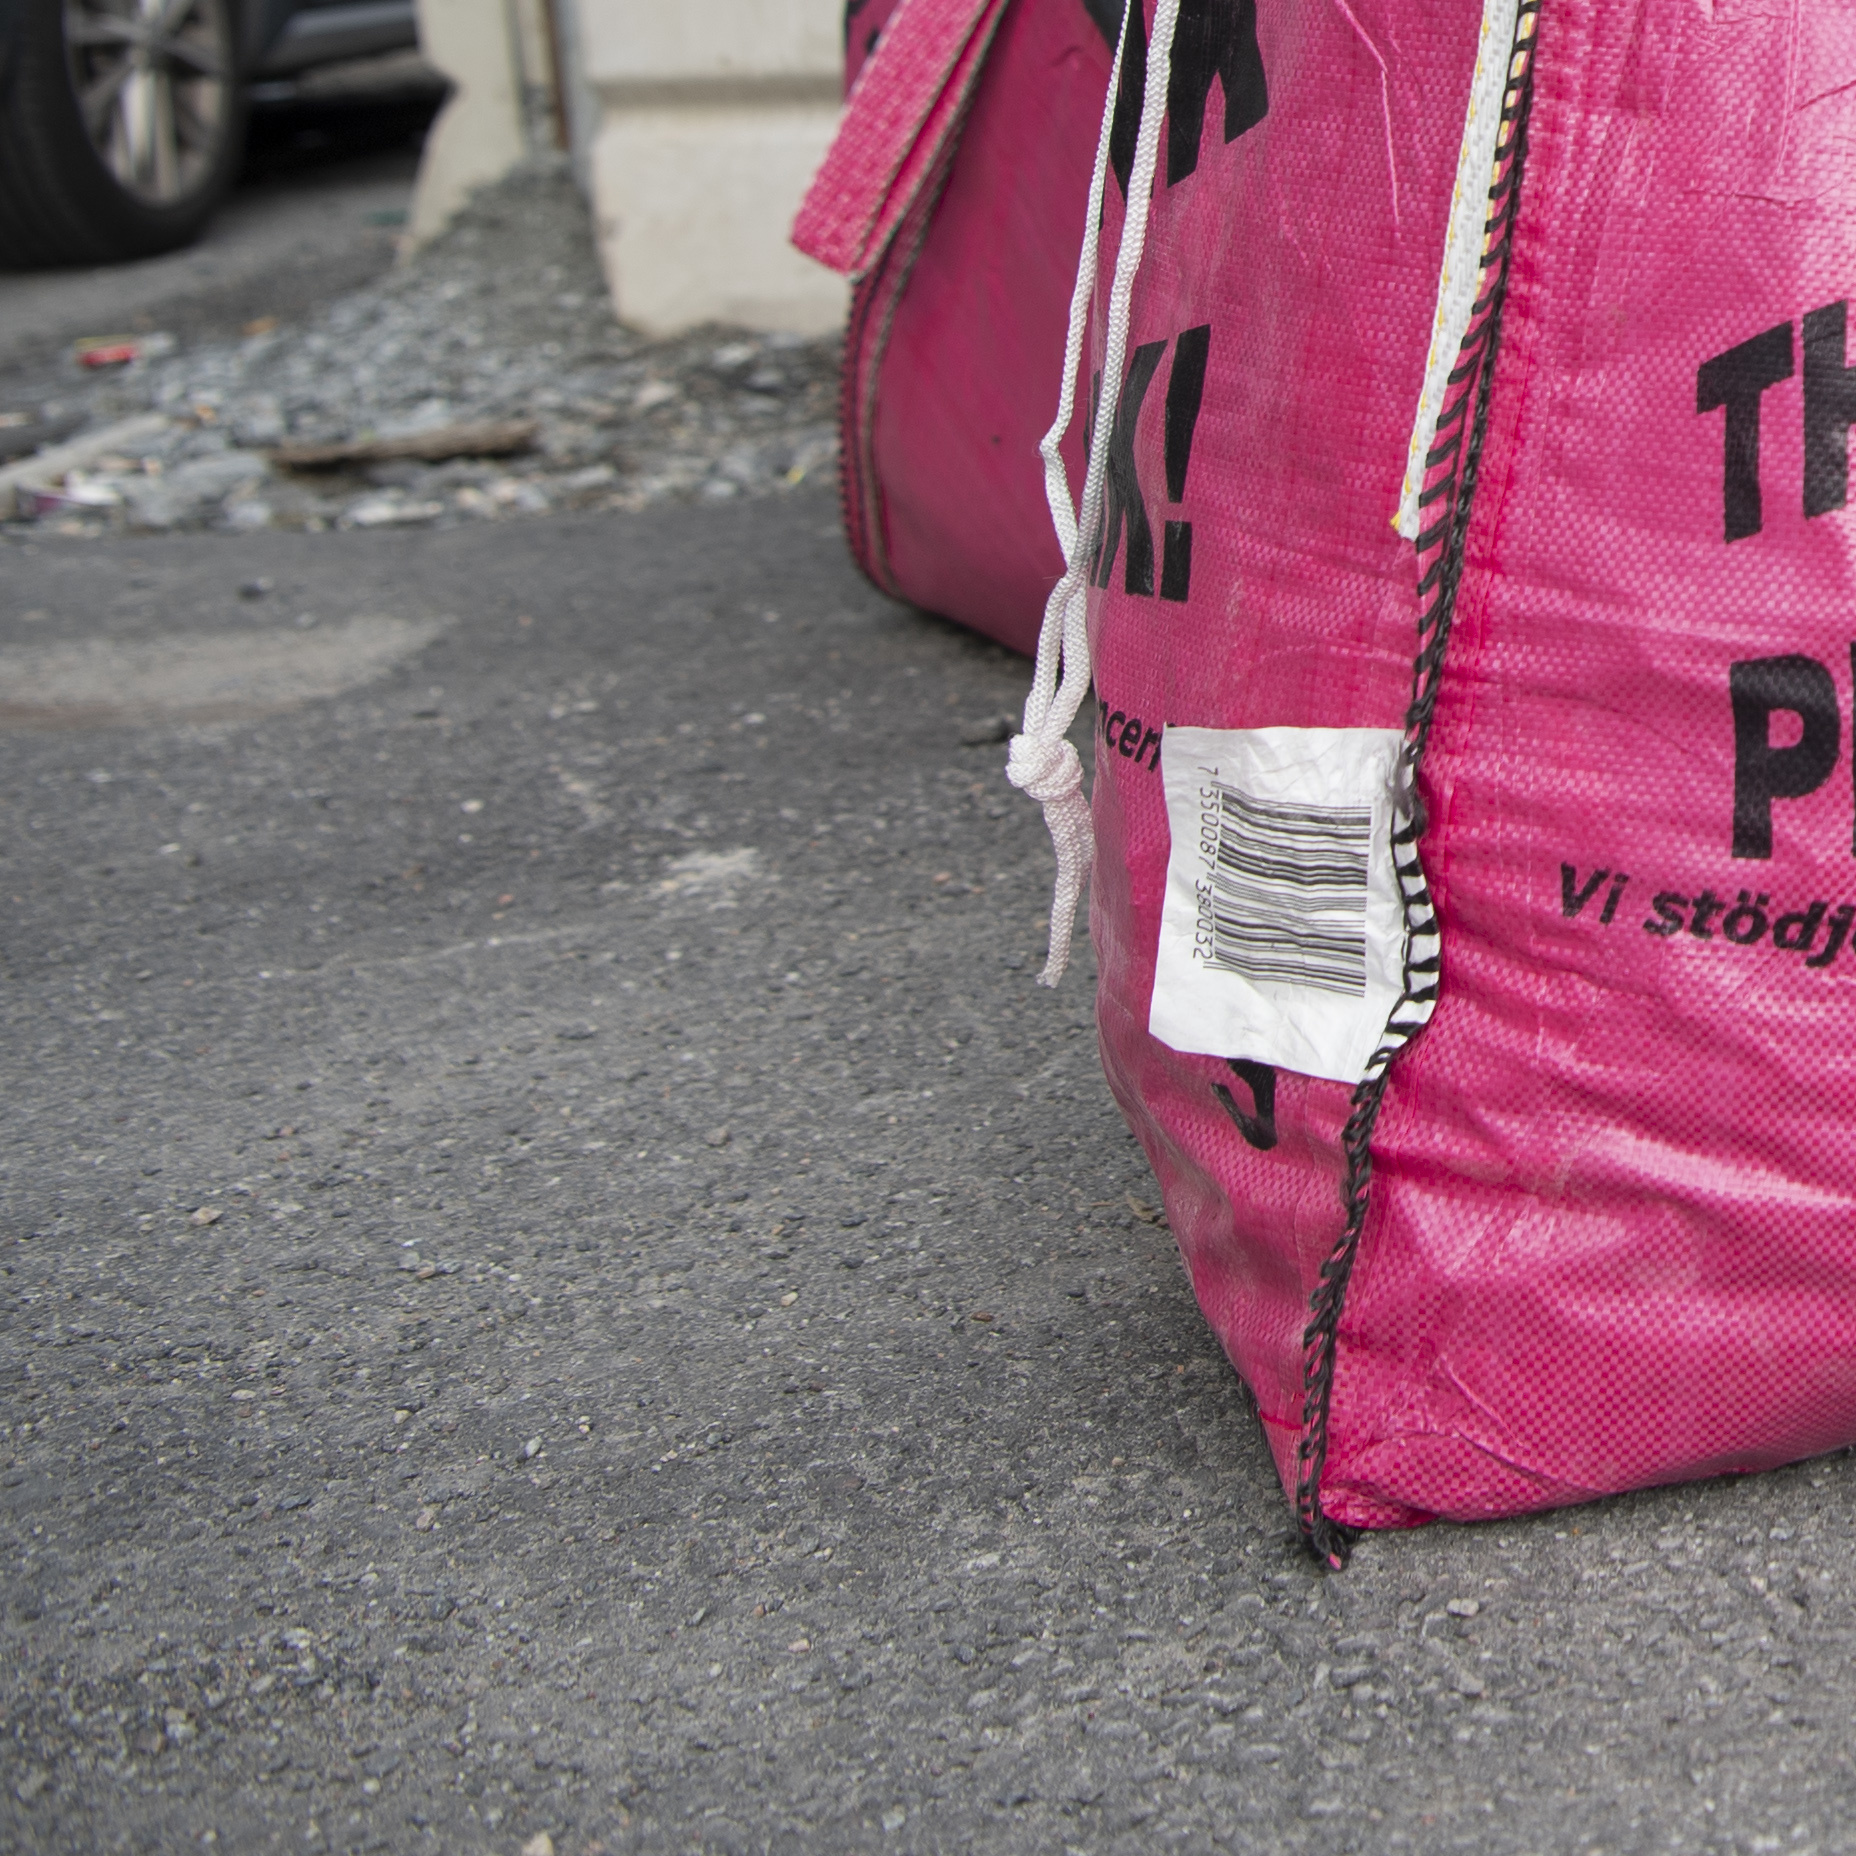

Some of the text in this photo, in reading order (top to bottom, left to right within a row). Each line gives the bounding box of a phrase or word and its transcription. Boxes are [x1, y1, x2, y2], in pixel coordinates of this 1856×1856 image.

[1198, 786, 1220, 871] 350087
[1192, 877, 1215, 961] 380032
[1558, 860, 1632, 925] Vi
